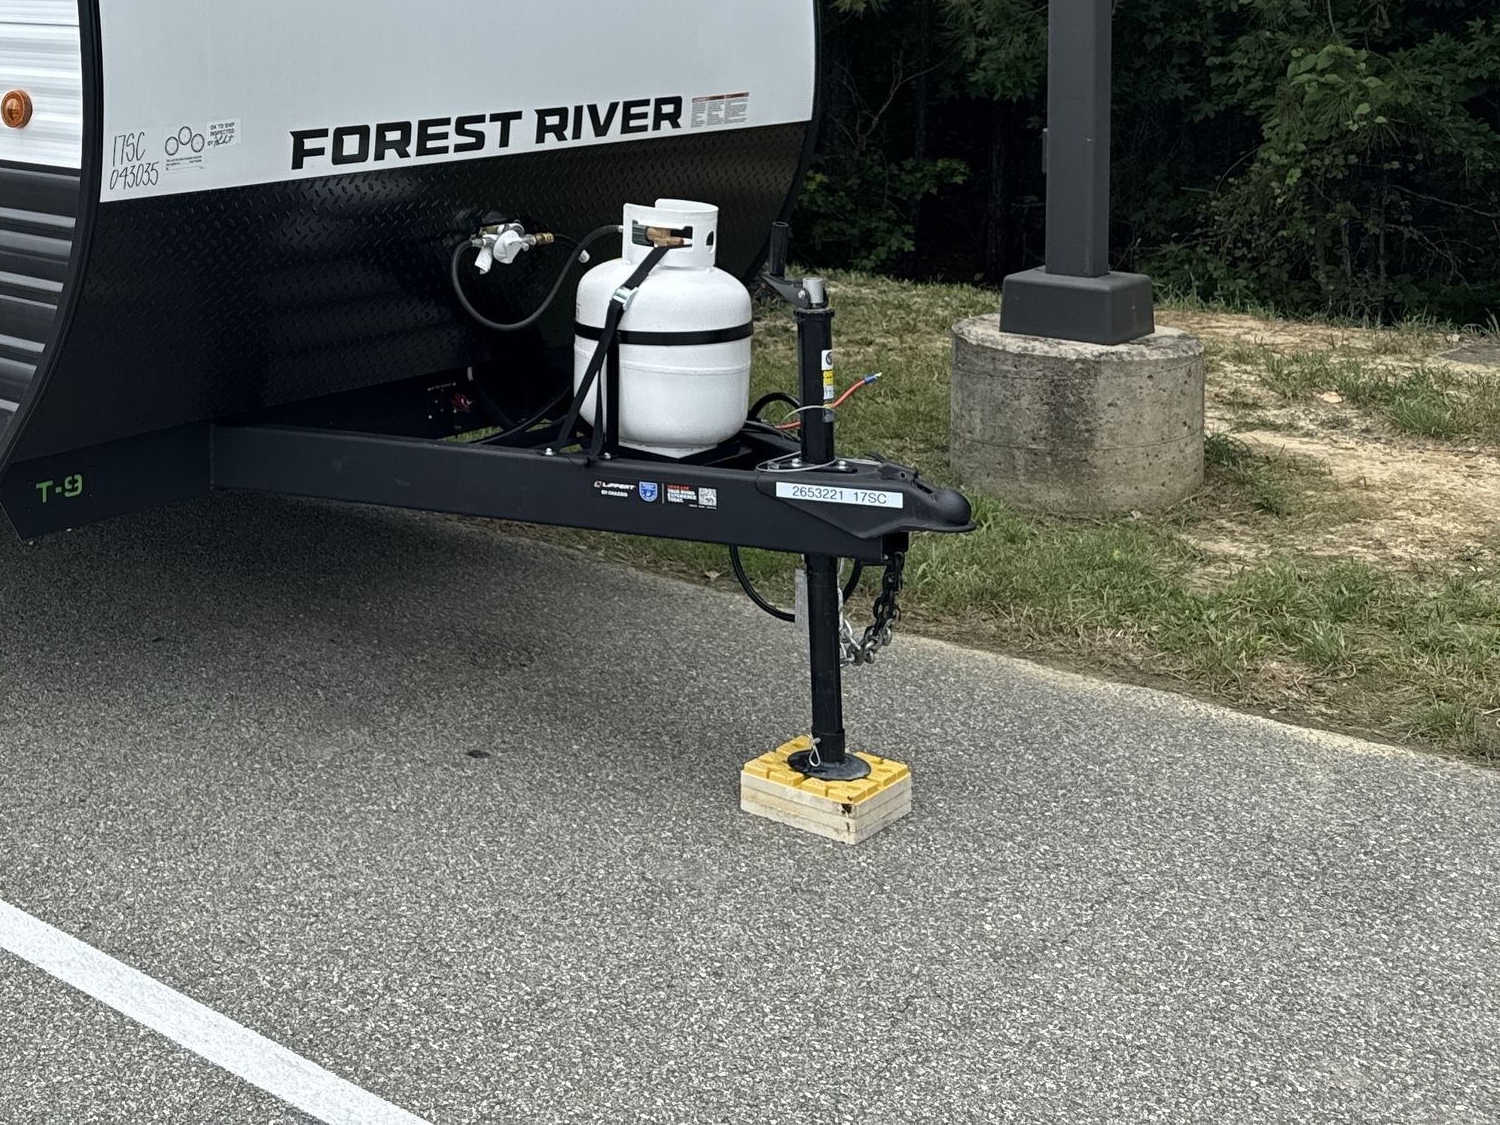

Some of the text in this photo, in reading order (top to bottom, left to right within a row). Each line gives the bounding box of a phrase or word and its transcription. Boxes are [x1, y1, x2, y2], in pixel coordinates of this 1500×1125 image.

[290, 110, 523, 170] FOREST
[534, 95, 683, 144] RIVER
[112, 131, 146, 167] 17SC
[110, 161, 160, 190] 043035
[35, 474, 83, 503] T-9
[792, 486, 887, 505] 2653221 17SC
